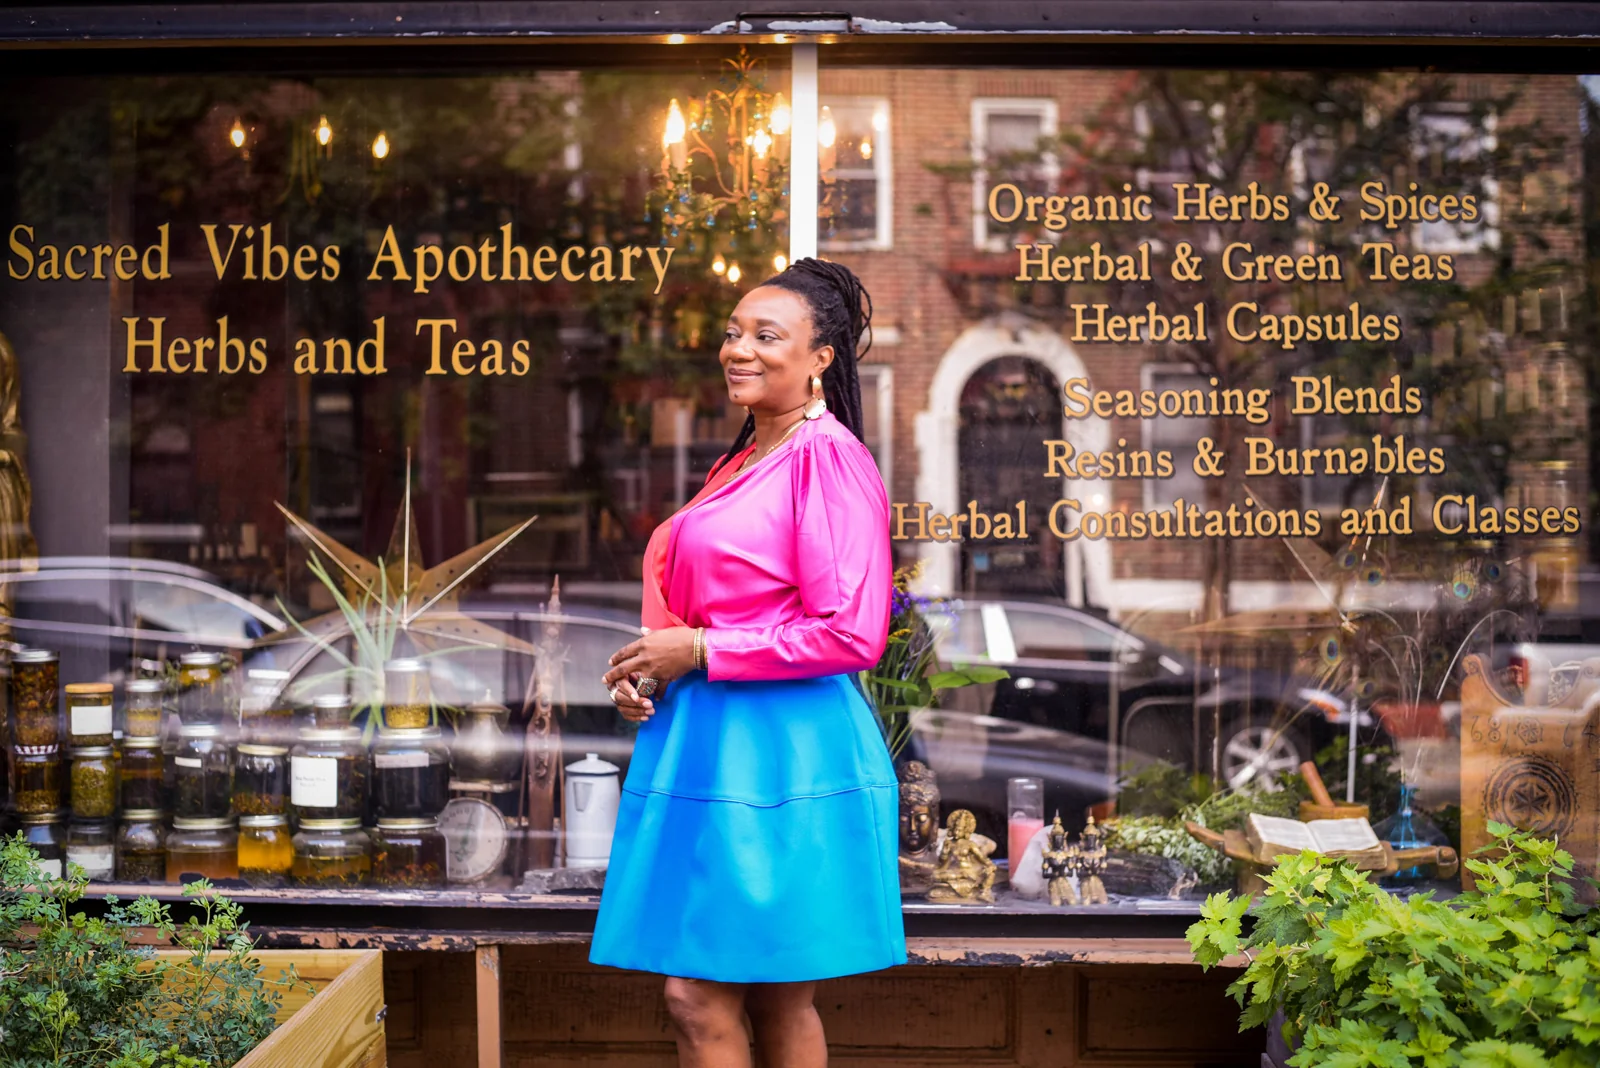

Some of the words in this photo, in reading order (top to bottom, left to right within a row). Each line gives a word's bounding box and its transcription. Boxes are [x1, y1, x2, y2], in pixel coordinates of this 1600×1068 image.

[988, 183, 1151, 229] Organic
[1174, 182, 1289, 222] Herbs
[1309, 182, 1340, 222] &
[1360, 182, 1478, 228] Spices
[8, 223, 171, 281] Sacred
[201, 223, 340, 281] Vibes
[367, 223, 675, 294] Apothecary
[1015, 244, 1151, 282] Herbal
[1172, 244, 1202, 282] &
[1223, 244, 1341, 282] Green
[1362, 242, 1453, 280] Teas
[122, 316, 267, 374] Herbs
[294, 316, 387, 374] and
[416, 318, 530, 376] Teas
[1071, 303, 1206, 341] Herbal
[1226, 302, 1400, 348] Capsules
[1063, 378, 1270, 422] Seasoning
[1291, 375, 1421, 415] Blends
[1043, 440, 1173, 477] Resins
[1193, 437, 1224, 476] &
[1245, 435, 1444, 475] Burnables
[892, 500, 1028, 539] Herbal
[1049, 498, 1321, 539] Consultations
[1341, 495, 1411, 536] and
[1433, 494, 1580, 535] Classes
